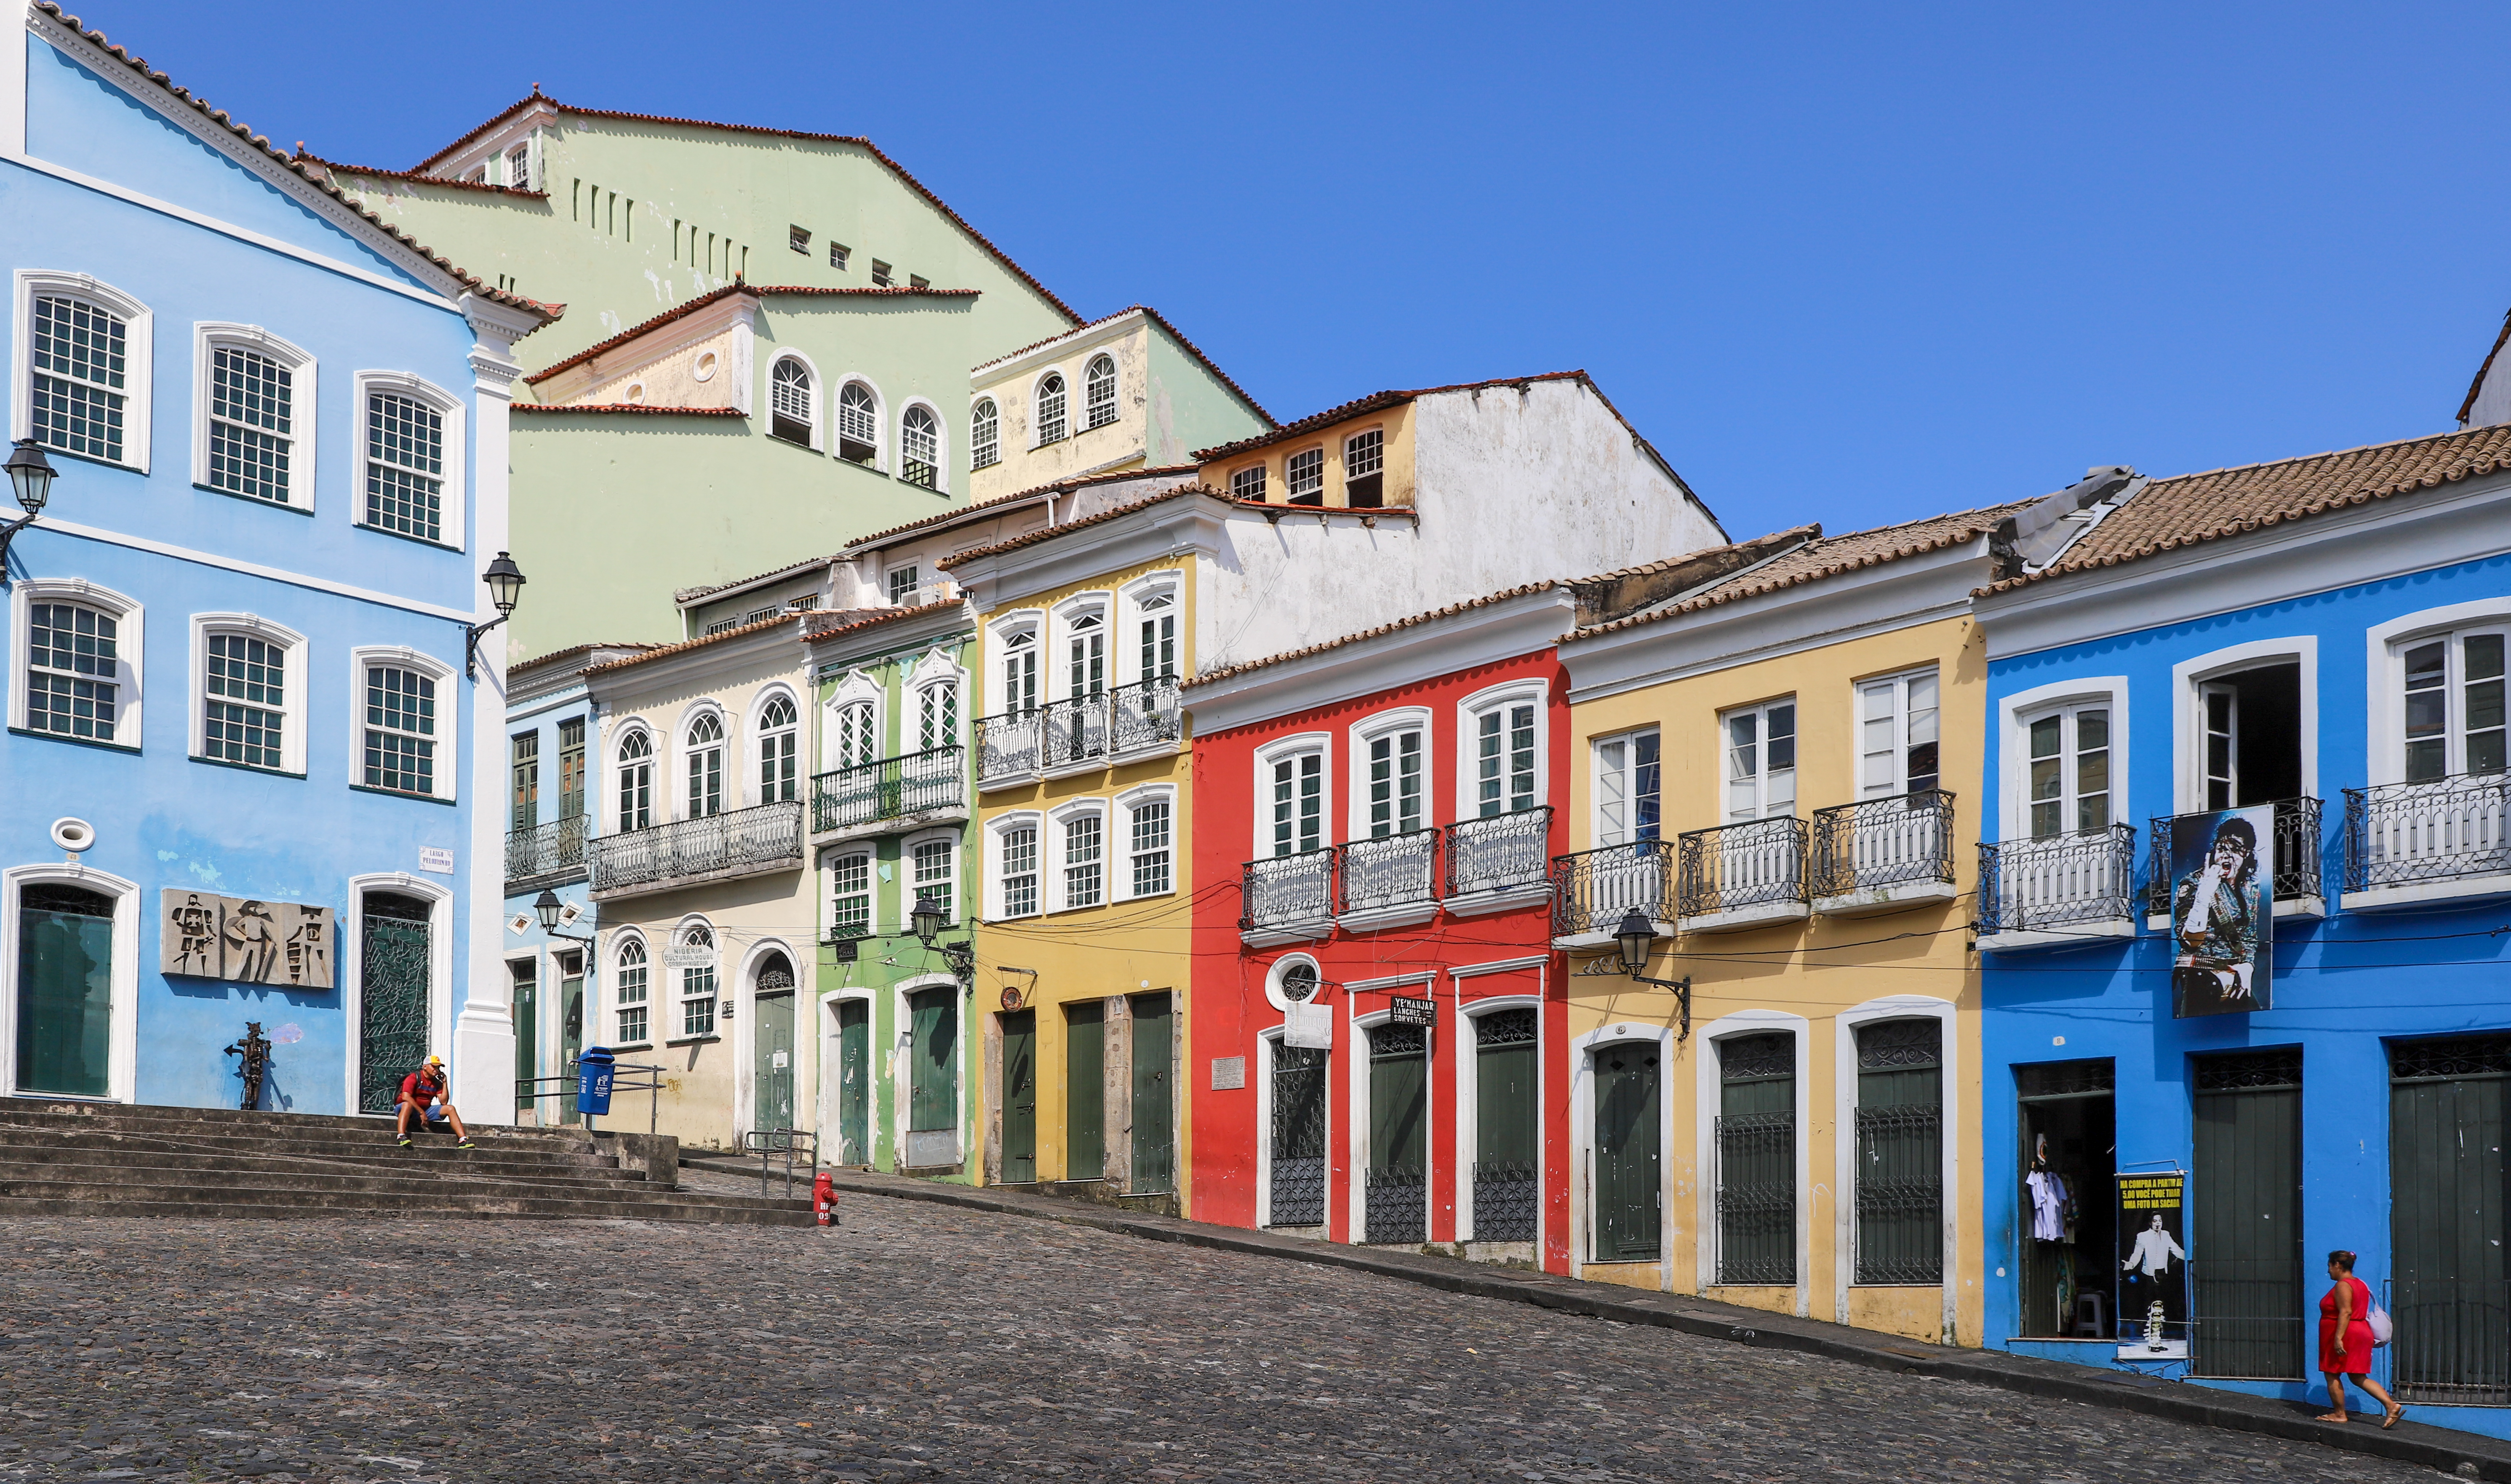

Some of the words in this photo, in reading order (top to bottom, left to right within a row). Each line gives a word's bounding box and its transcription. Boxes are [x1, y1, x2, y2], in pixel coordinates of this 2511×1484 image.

[423, 857, 451, 866] PELOURINHO
[1393, 1007, 1421, 1017] LANCHES
[1394, 1014, 1427, 1025] SORVETES
[2120, 1180, 2128, 1189] NA
[2128, 1179, 2152, 1188] COMPRA
[2152, 1179, 2156, 1188] A
[2157, 1178, 2176, 1188] PARTIR
[2176, 1178, 2183, 1187] DE
[2122, 1190, 2135, 1199] 5,00
[2135, 1188, 2150, 1198] VOCÊ
[2151, 1189, 2165, 1198] PODE
[2166, 1188, 2180, 1197] TIRAR
[2124, 1200, 2136, 1209] UMA
[2137, 1200, 2151, 1208] FOTO
[2151, 1199, 2159, 1208] NA
[2160, 1199, 2180, 1207] SACADA
